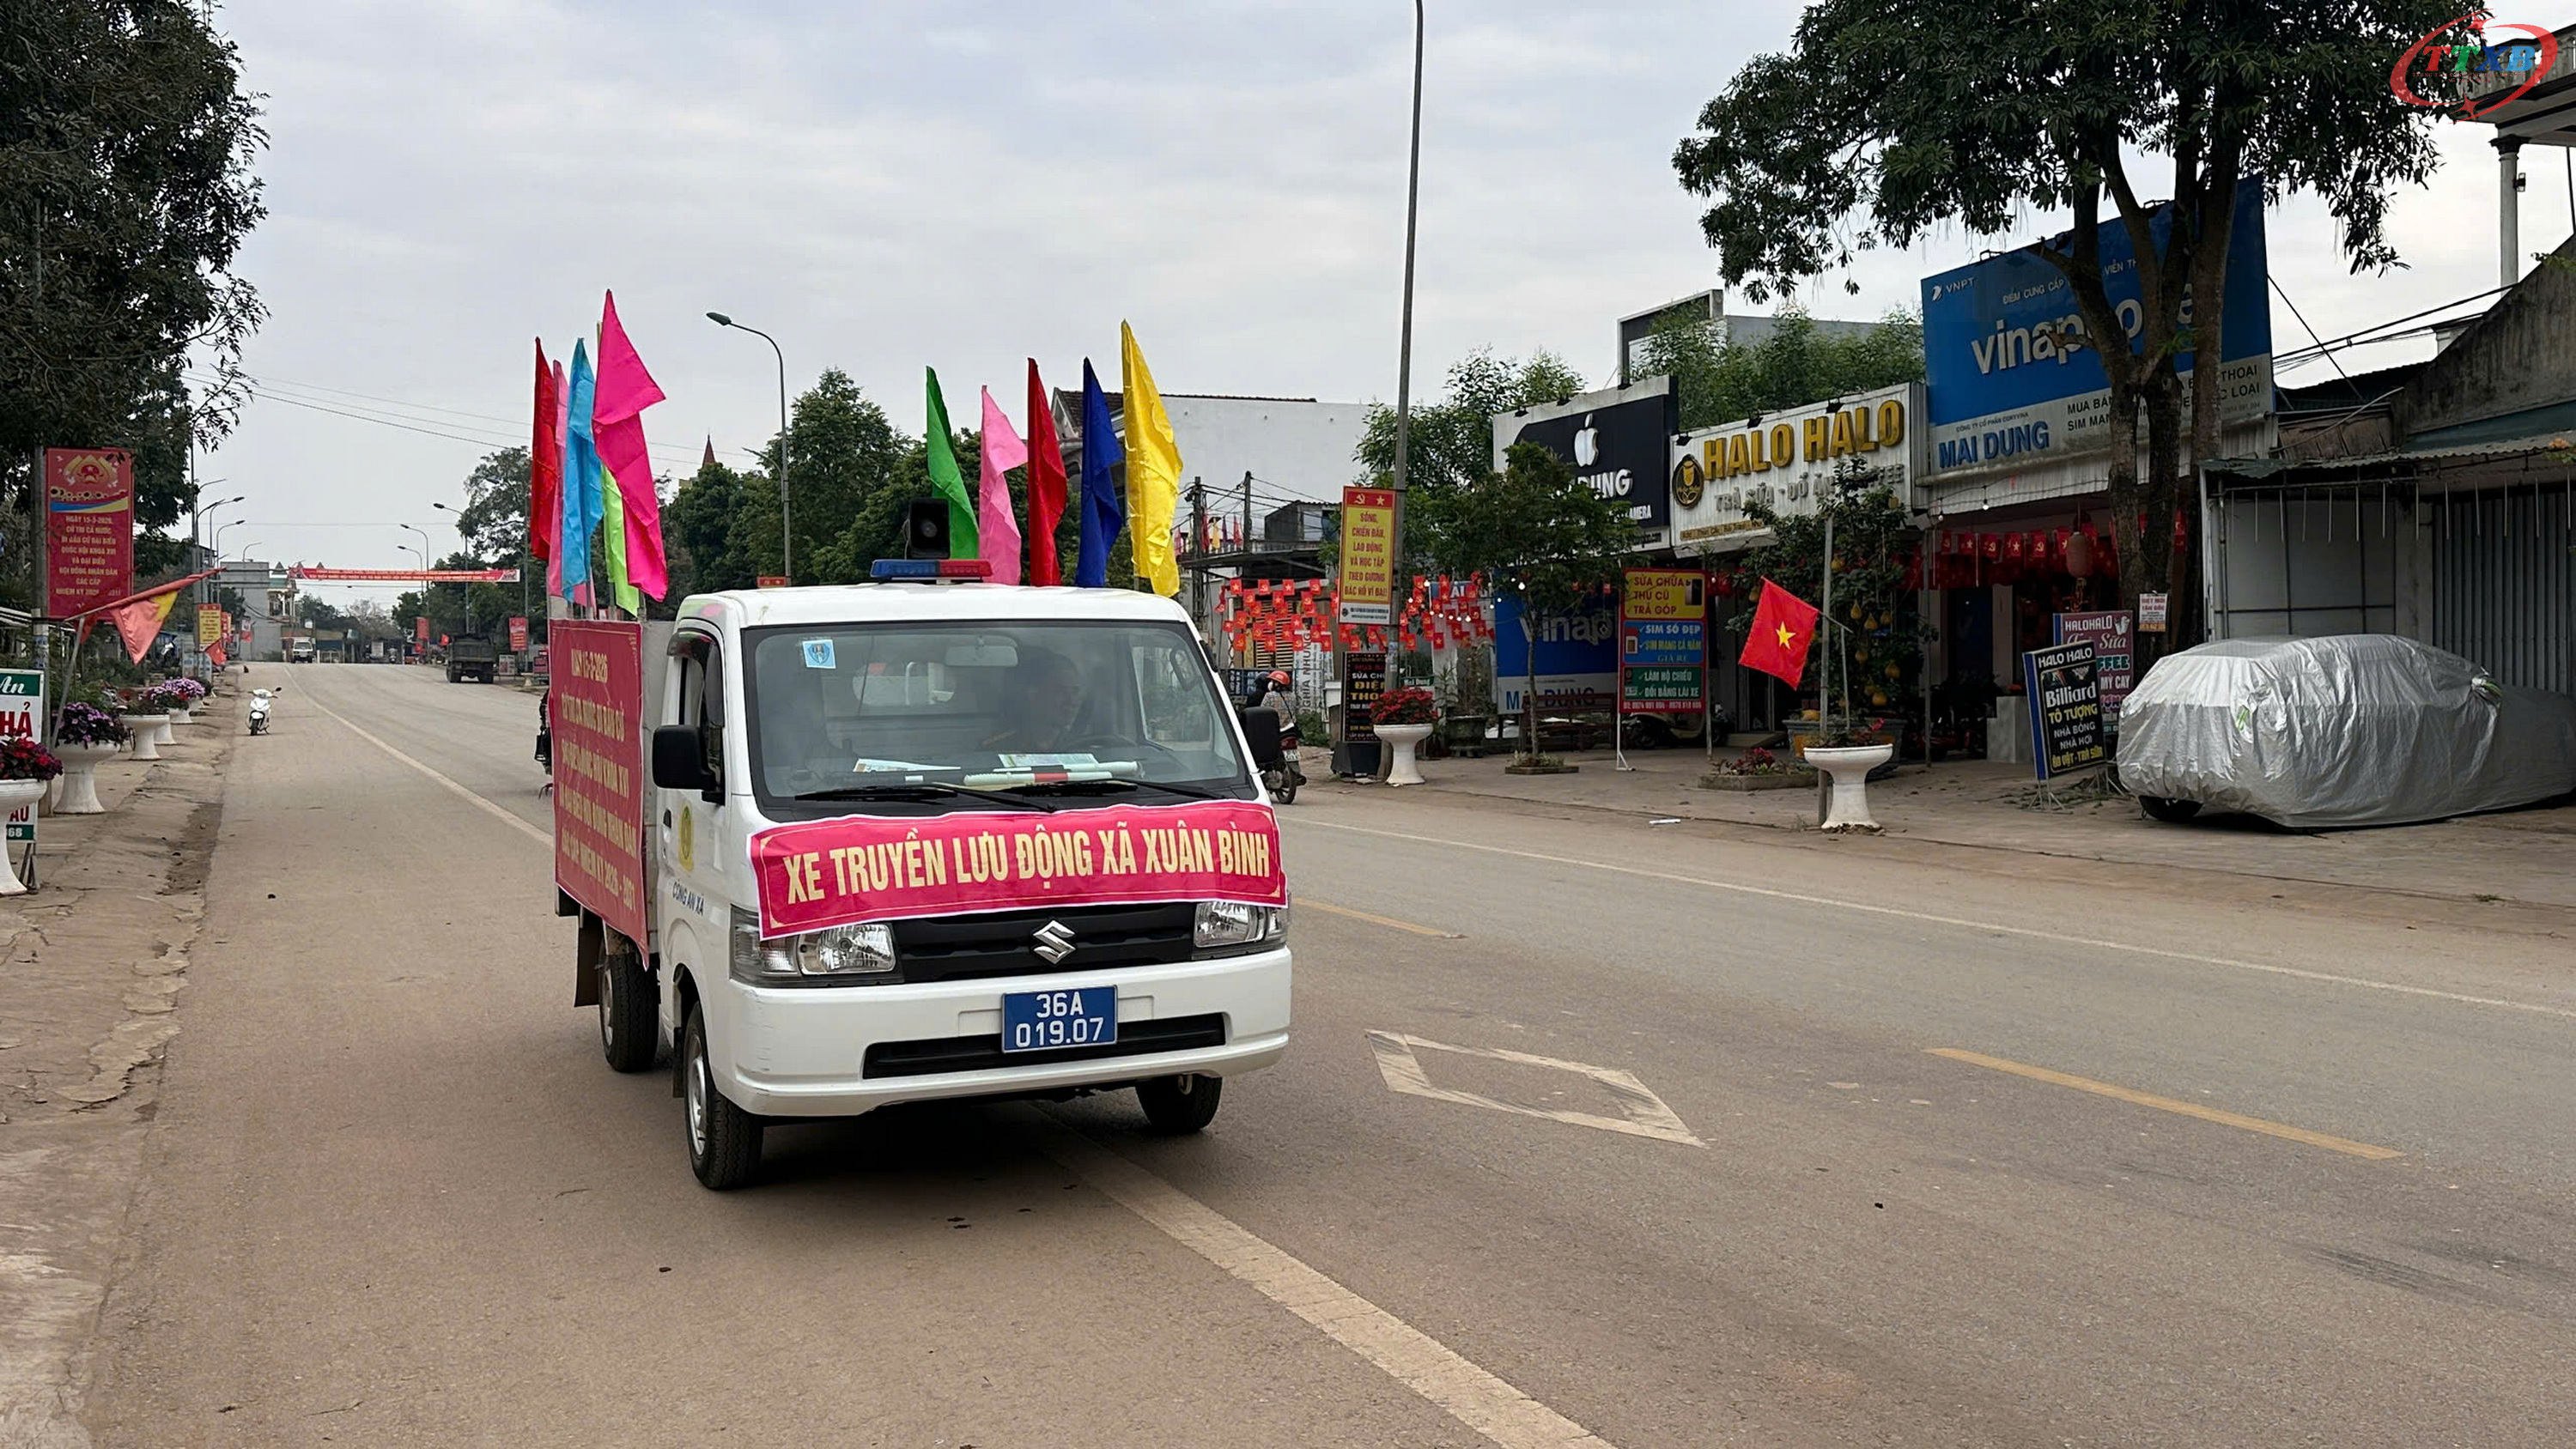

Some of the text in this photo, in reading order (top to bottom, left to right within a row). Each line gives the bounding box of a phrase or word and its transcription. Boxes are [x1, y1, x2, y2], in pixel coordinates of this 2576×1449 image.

[1946, 276, 1975, 293] VNPT
[2002, 289, 2020, 305] ĐIỂM
[2024, 284, 2044, 299] CUNG
[2048, 278, 2064, 292] CẤP
[1971, 282, 2193, 374] vinapoe
[2068, 398, 2090, 415] MUA
[2068, 419, 2087, 431] SIM
[2231, 384, 2260, 398] LOẠI
[1704, 399, 1905, 481] HALO HALO
[1939, 421, 2050, 469] MAI DUNG
[1626, 505, 1652, 519] AMERA
[1352, 542, 1383, 555] LAO ĐỘNG
[1350, 555, 1385, 568] VÀ HỌC TẬP
[1348, 571, 1364, 581] THEO
[1634, 573, 1685, 587] SỬA CHỮA
[1344, 585, 1358, 596] BÁC
[1358, 585, 1367, 597] HỒ
[1655, 604, 1677, 615] GÓP
[1645, 621, 1701, 637] SIM SỐ ĐẸP
[1302, 633, 1311, 675] NHUNG
[2038, 646, 2093, 669] HALO HALO
[2096, 654, 2130, 671] FFEE
[2100, 674, 2130, 690] MỲ CAY
[1350, 692, 1379, 700] THO
[1690, 687, 1699, 697] XE
[2045, 681, 2097, 708] Billiard
[0, 701, 33, 737] HẢ
[2048, 707, 2063, 724] TÔ
[2063, 703, 2098, 721] TƯỢNG
[2053, 724, 2071, 739] NHÀ
[2059, 736, 2077, 750] NHÀ
[783, 820, 1270, 905] XE TRUYỀN LƯU ĐỘNG XÃ XUÂN BÌNH
[672, 880, 705, 916] CÔNG AN XÃ
[1036, 991, 1084, 1018] 36A
[1015, 1017, 1104, 1048] 019.07
